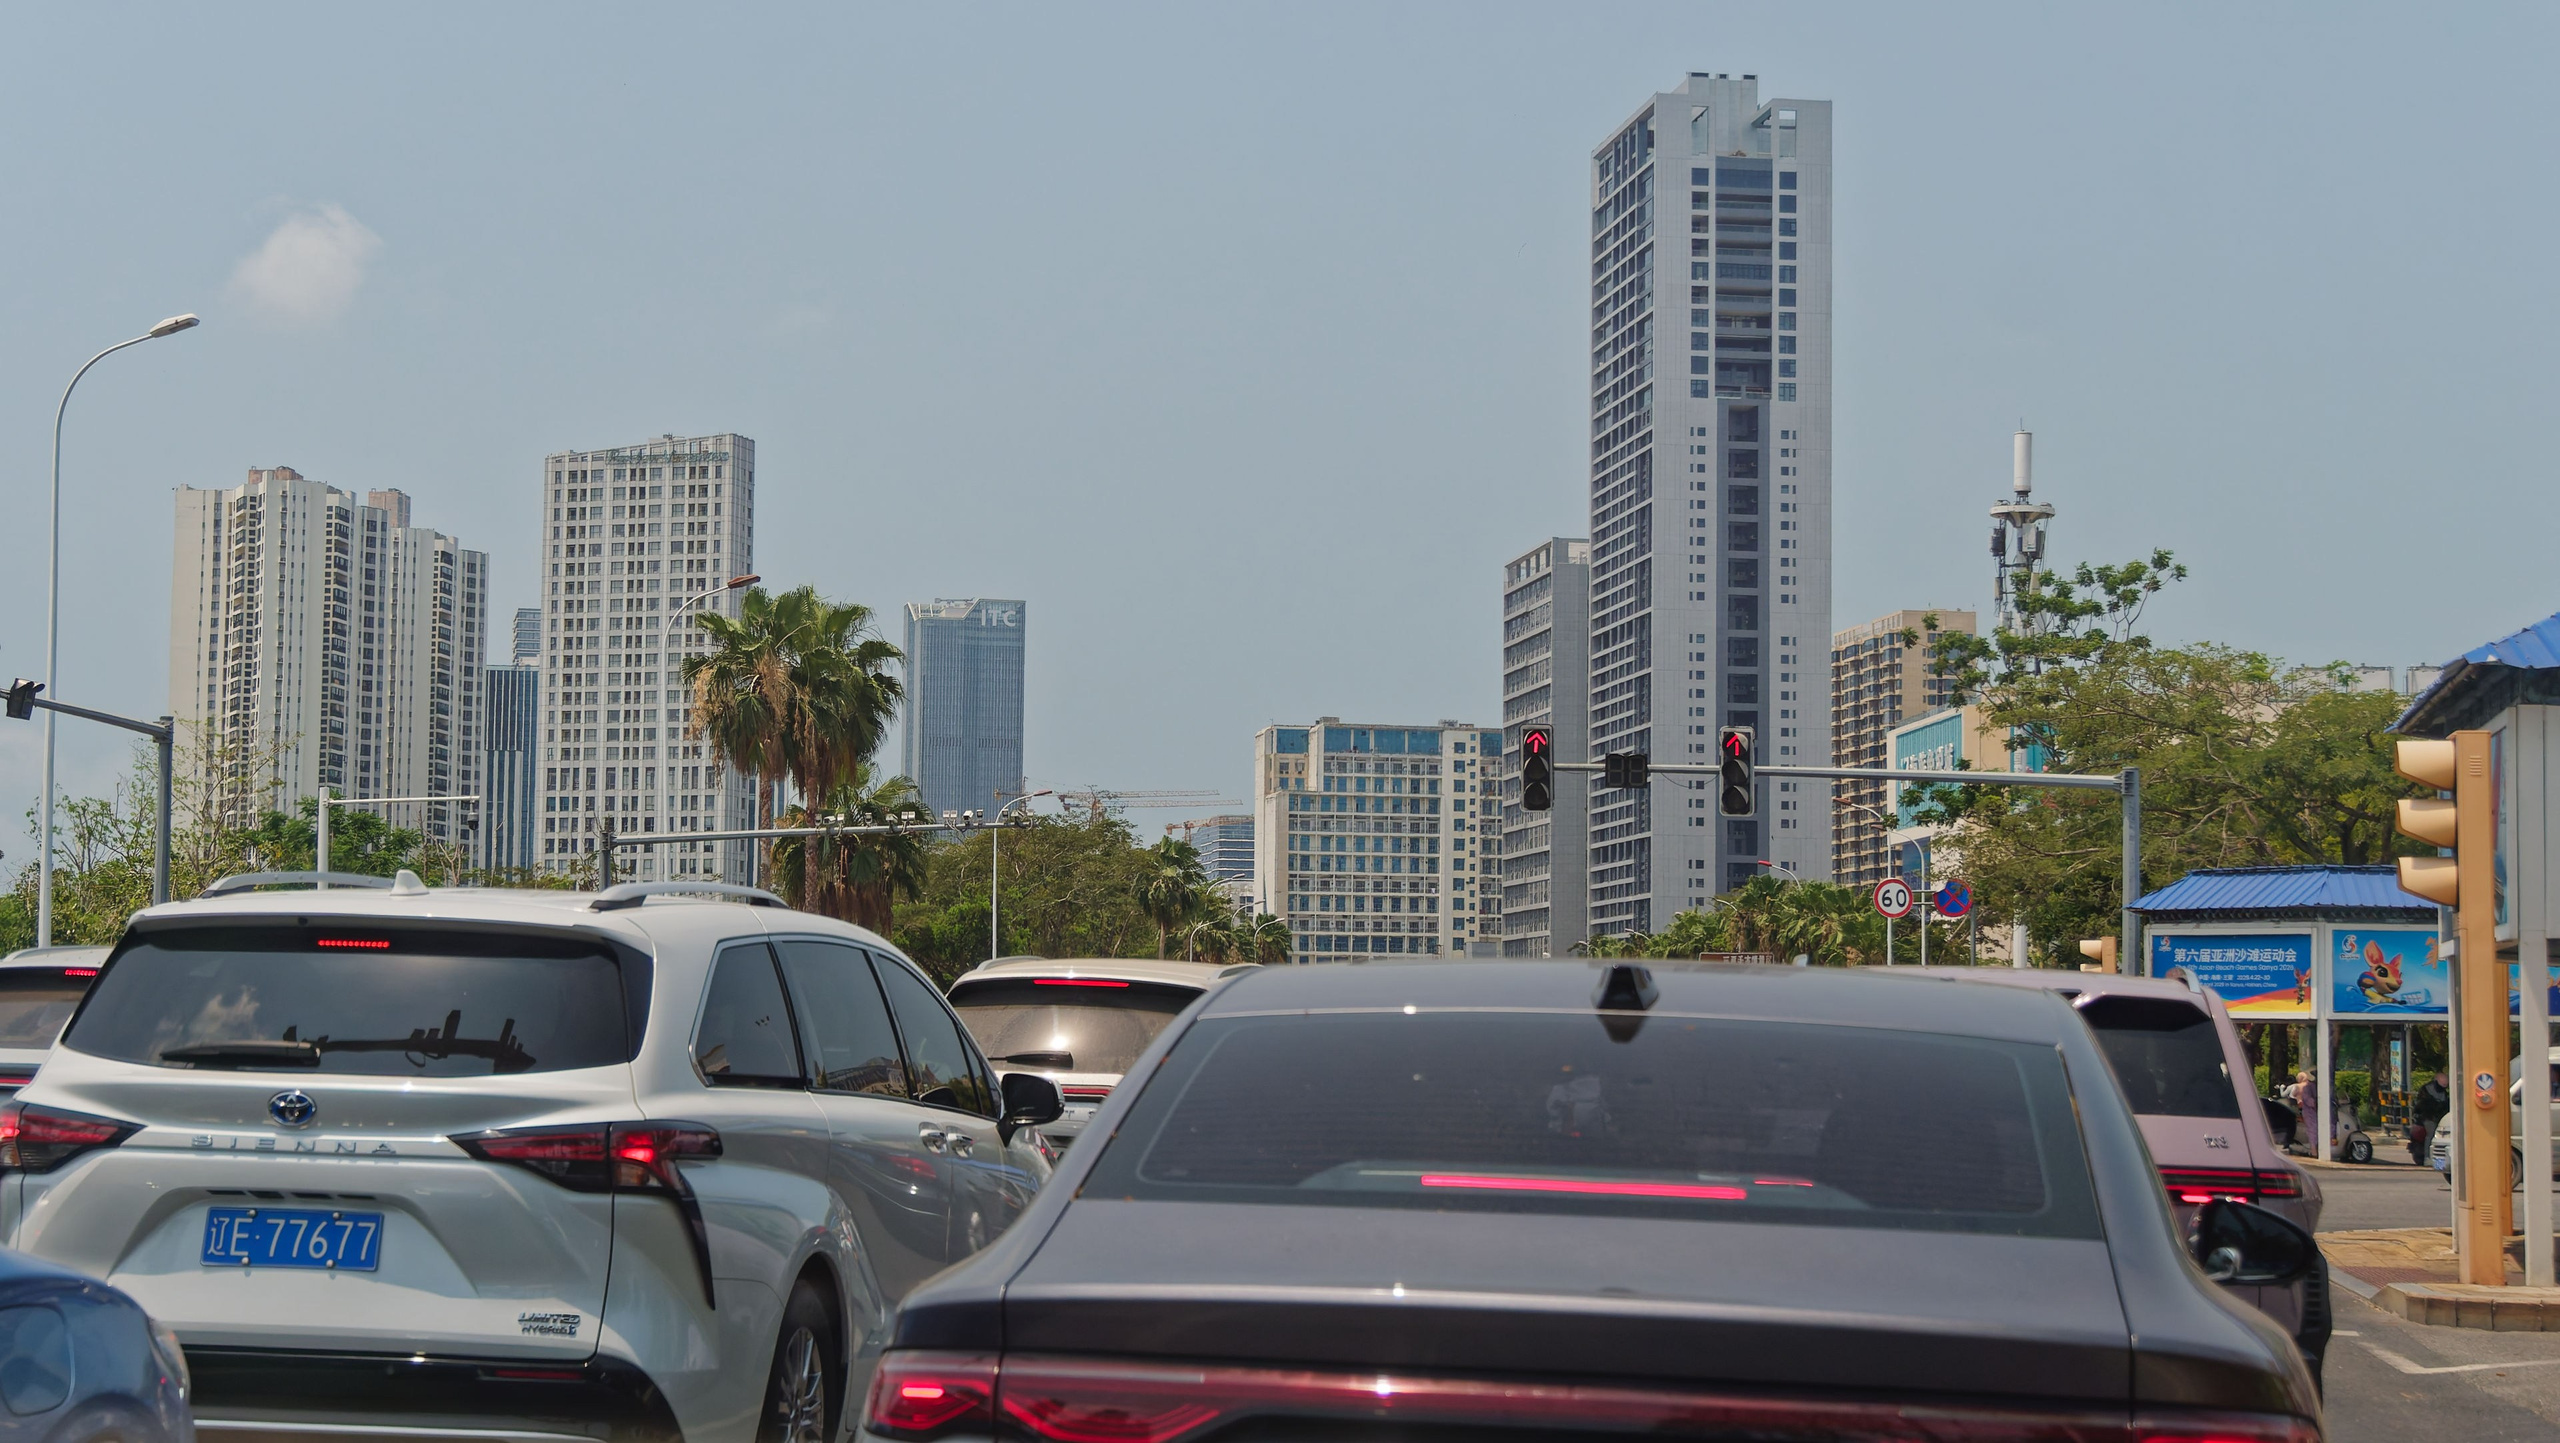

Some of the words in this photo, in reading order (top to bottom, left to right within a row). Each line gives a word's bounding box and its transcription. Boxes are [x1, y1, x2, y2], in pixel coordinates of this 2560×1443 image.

[981, 609, 1016, 627] ITC
[1882, 889, 1907, 908] 60
[2173, 947, 2297, 963] 第六届亚洲沙滩运动会
[191, 1135, 397, 1155] SIENNA
[518, 1312, 581, 1325] LIMITED
